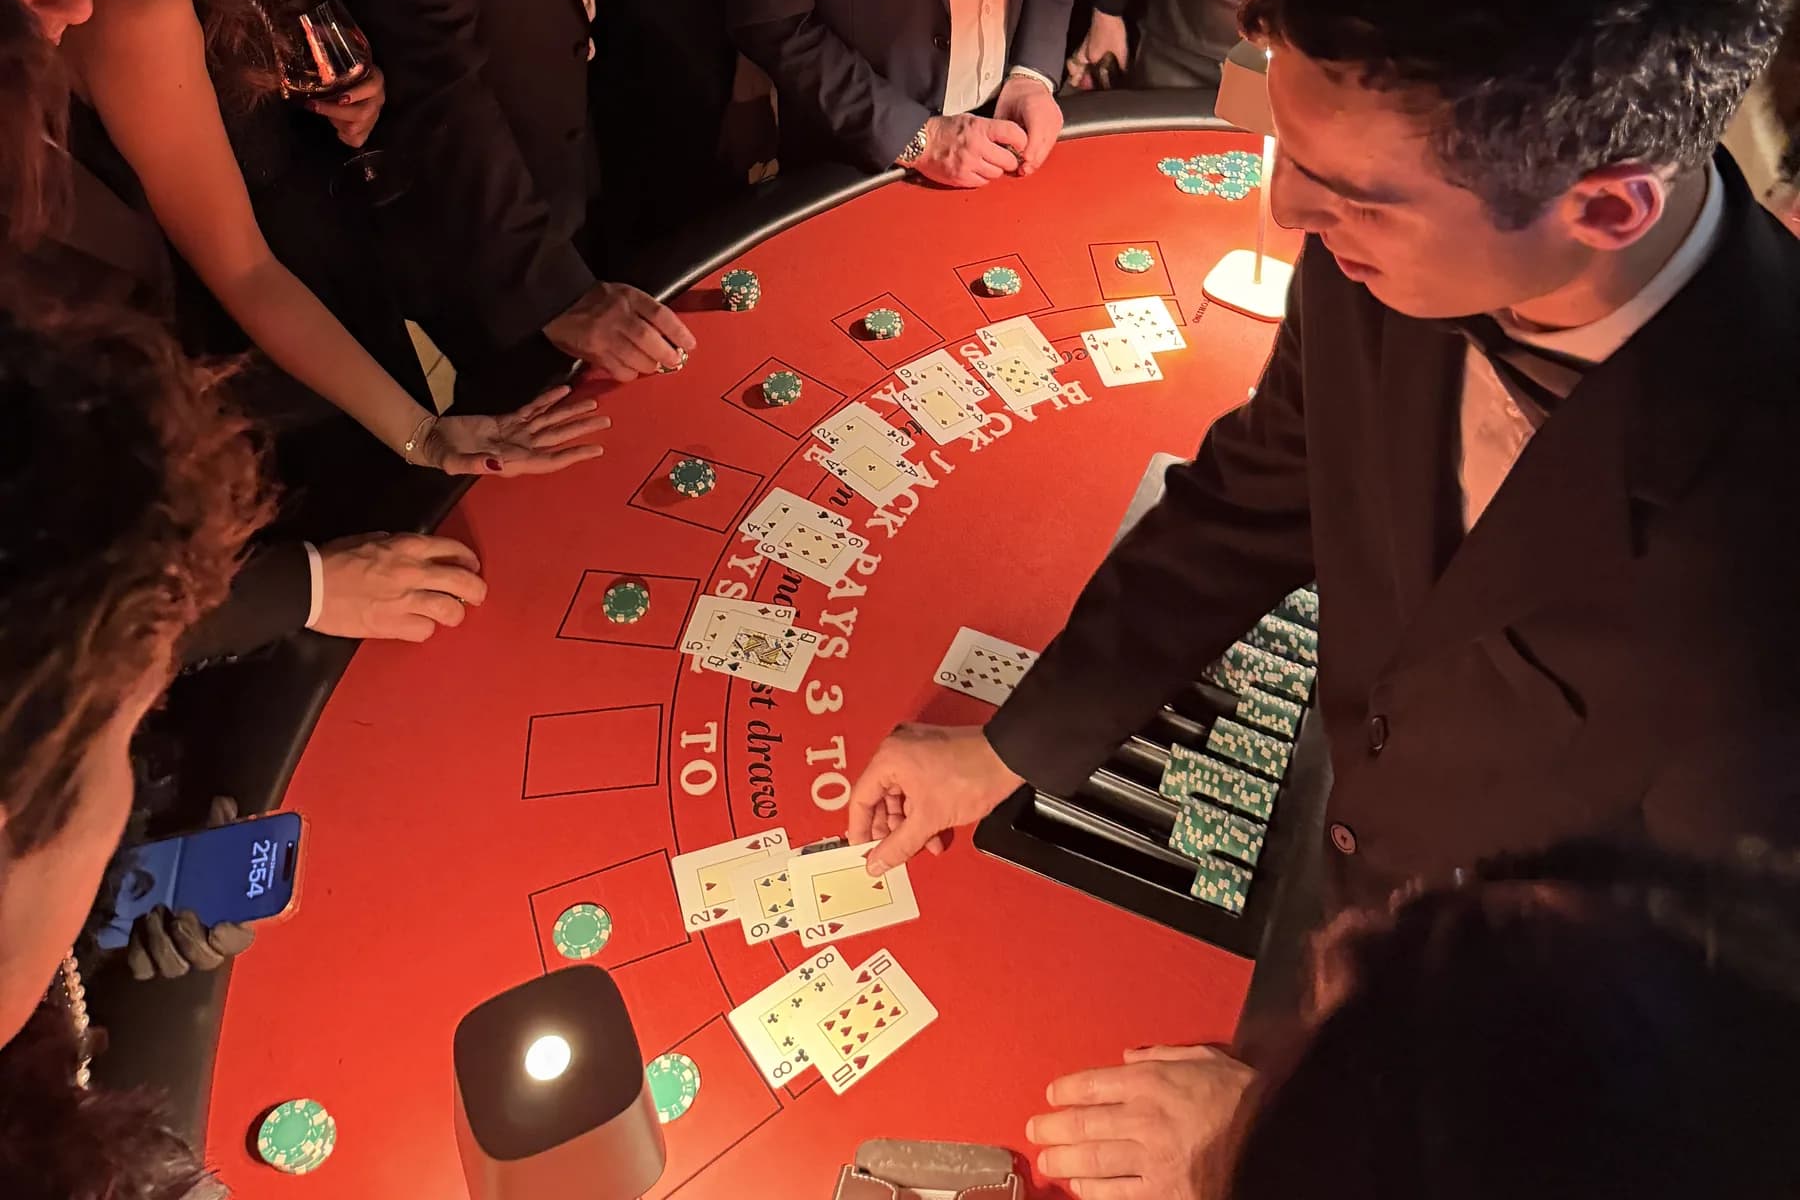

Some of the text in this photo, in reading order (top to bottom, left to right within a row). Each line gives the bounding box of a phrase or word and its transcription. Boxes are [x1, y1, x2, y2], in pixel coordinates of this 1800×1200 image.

[865, 450, 956, 539] JACK
[815, 553, 882, 659] PAYS
[805, 679, 844, 715] 3
[679, 721, 718, 796] TO
[747, 719, 783, 819] draw
[805, 735, 852, 812] TO
[763, 833, 783, 848] 2
[246, 839, 270, 899] 21:54
[690, 910, 710, 926] 2
[805, 923, 826, 940] 2
[816, 952, 835, 969] 8
[868, 954, 892, 976] 10
[772, 1061, 793, 1079] 8
[831, 1063, 857, 1088] 10
